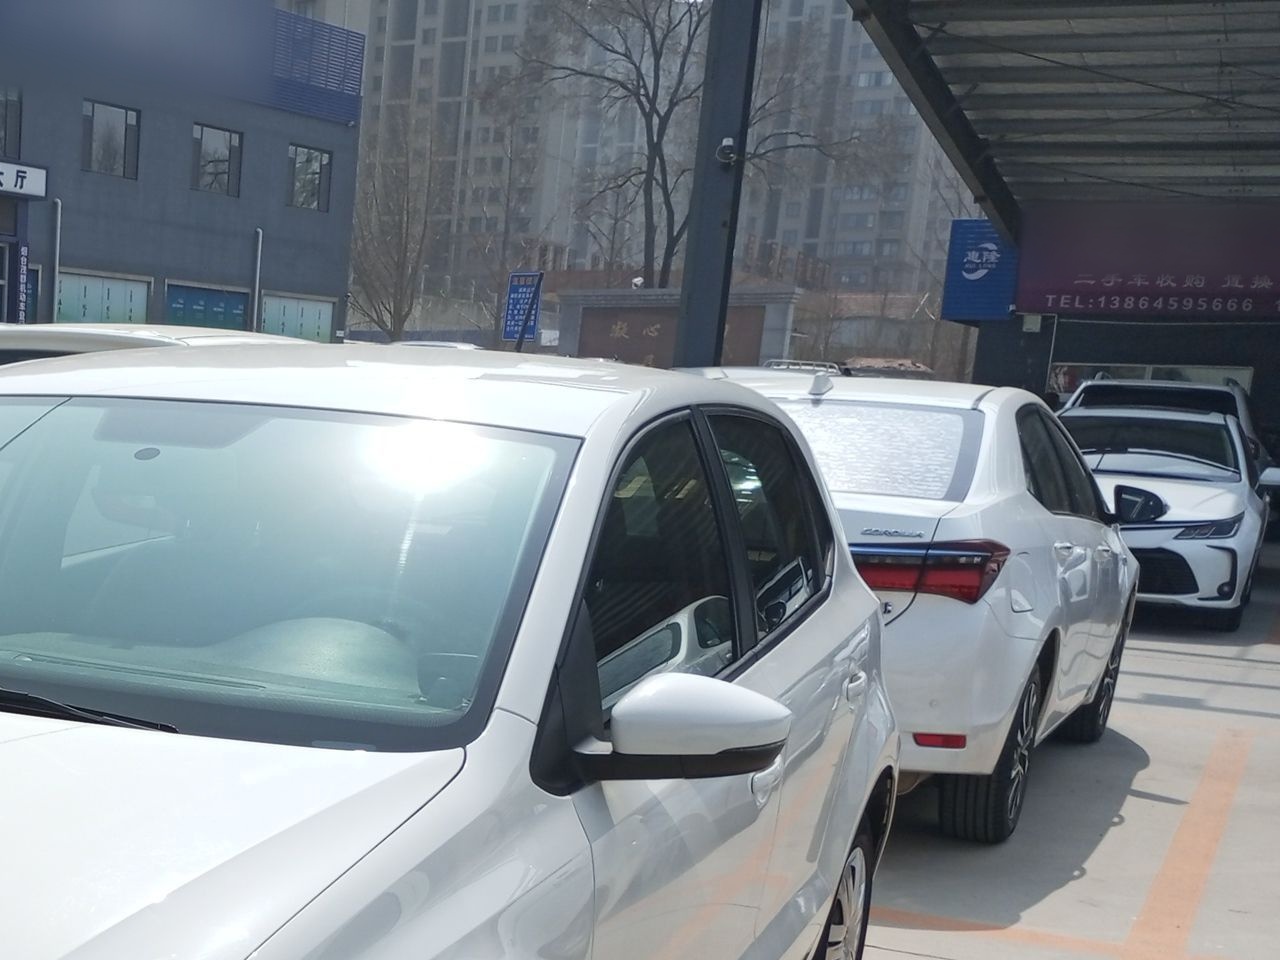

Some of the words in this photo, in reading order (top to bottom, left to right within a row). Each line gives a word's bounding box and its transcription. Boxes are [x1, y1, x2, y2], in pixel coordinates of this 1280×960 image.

[1073, 274, 1206, 288] 二手车收购
